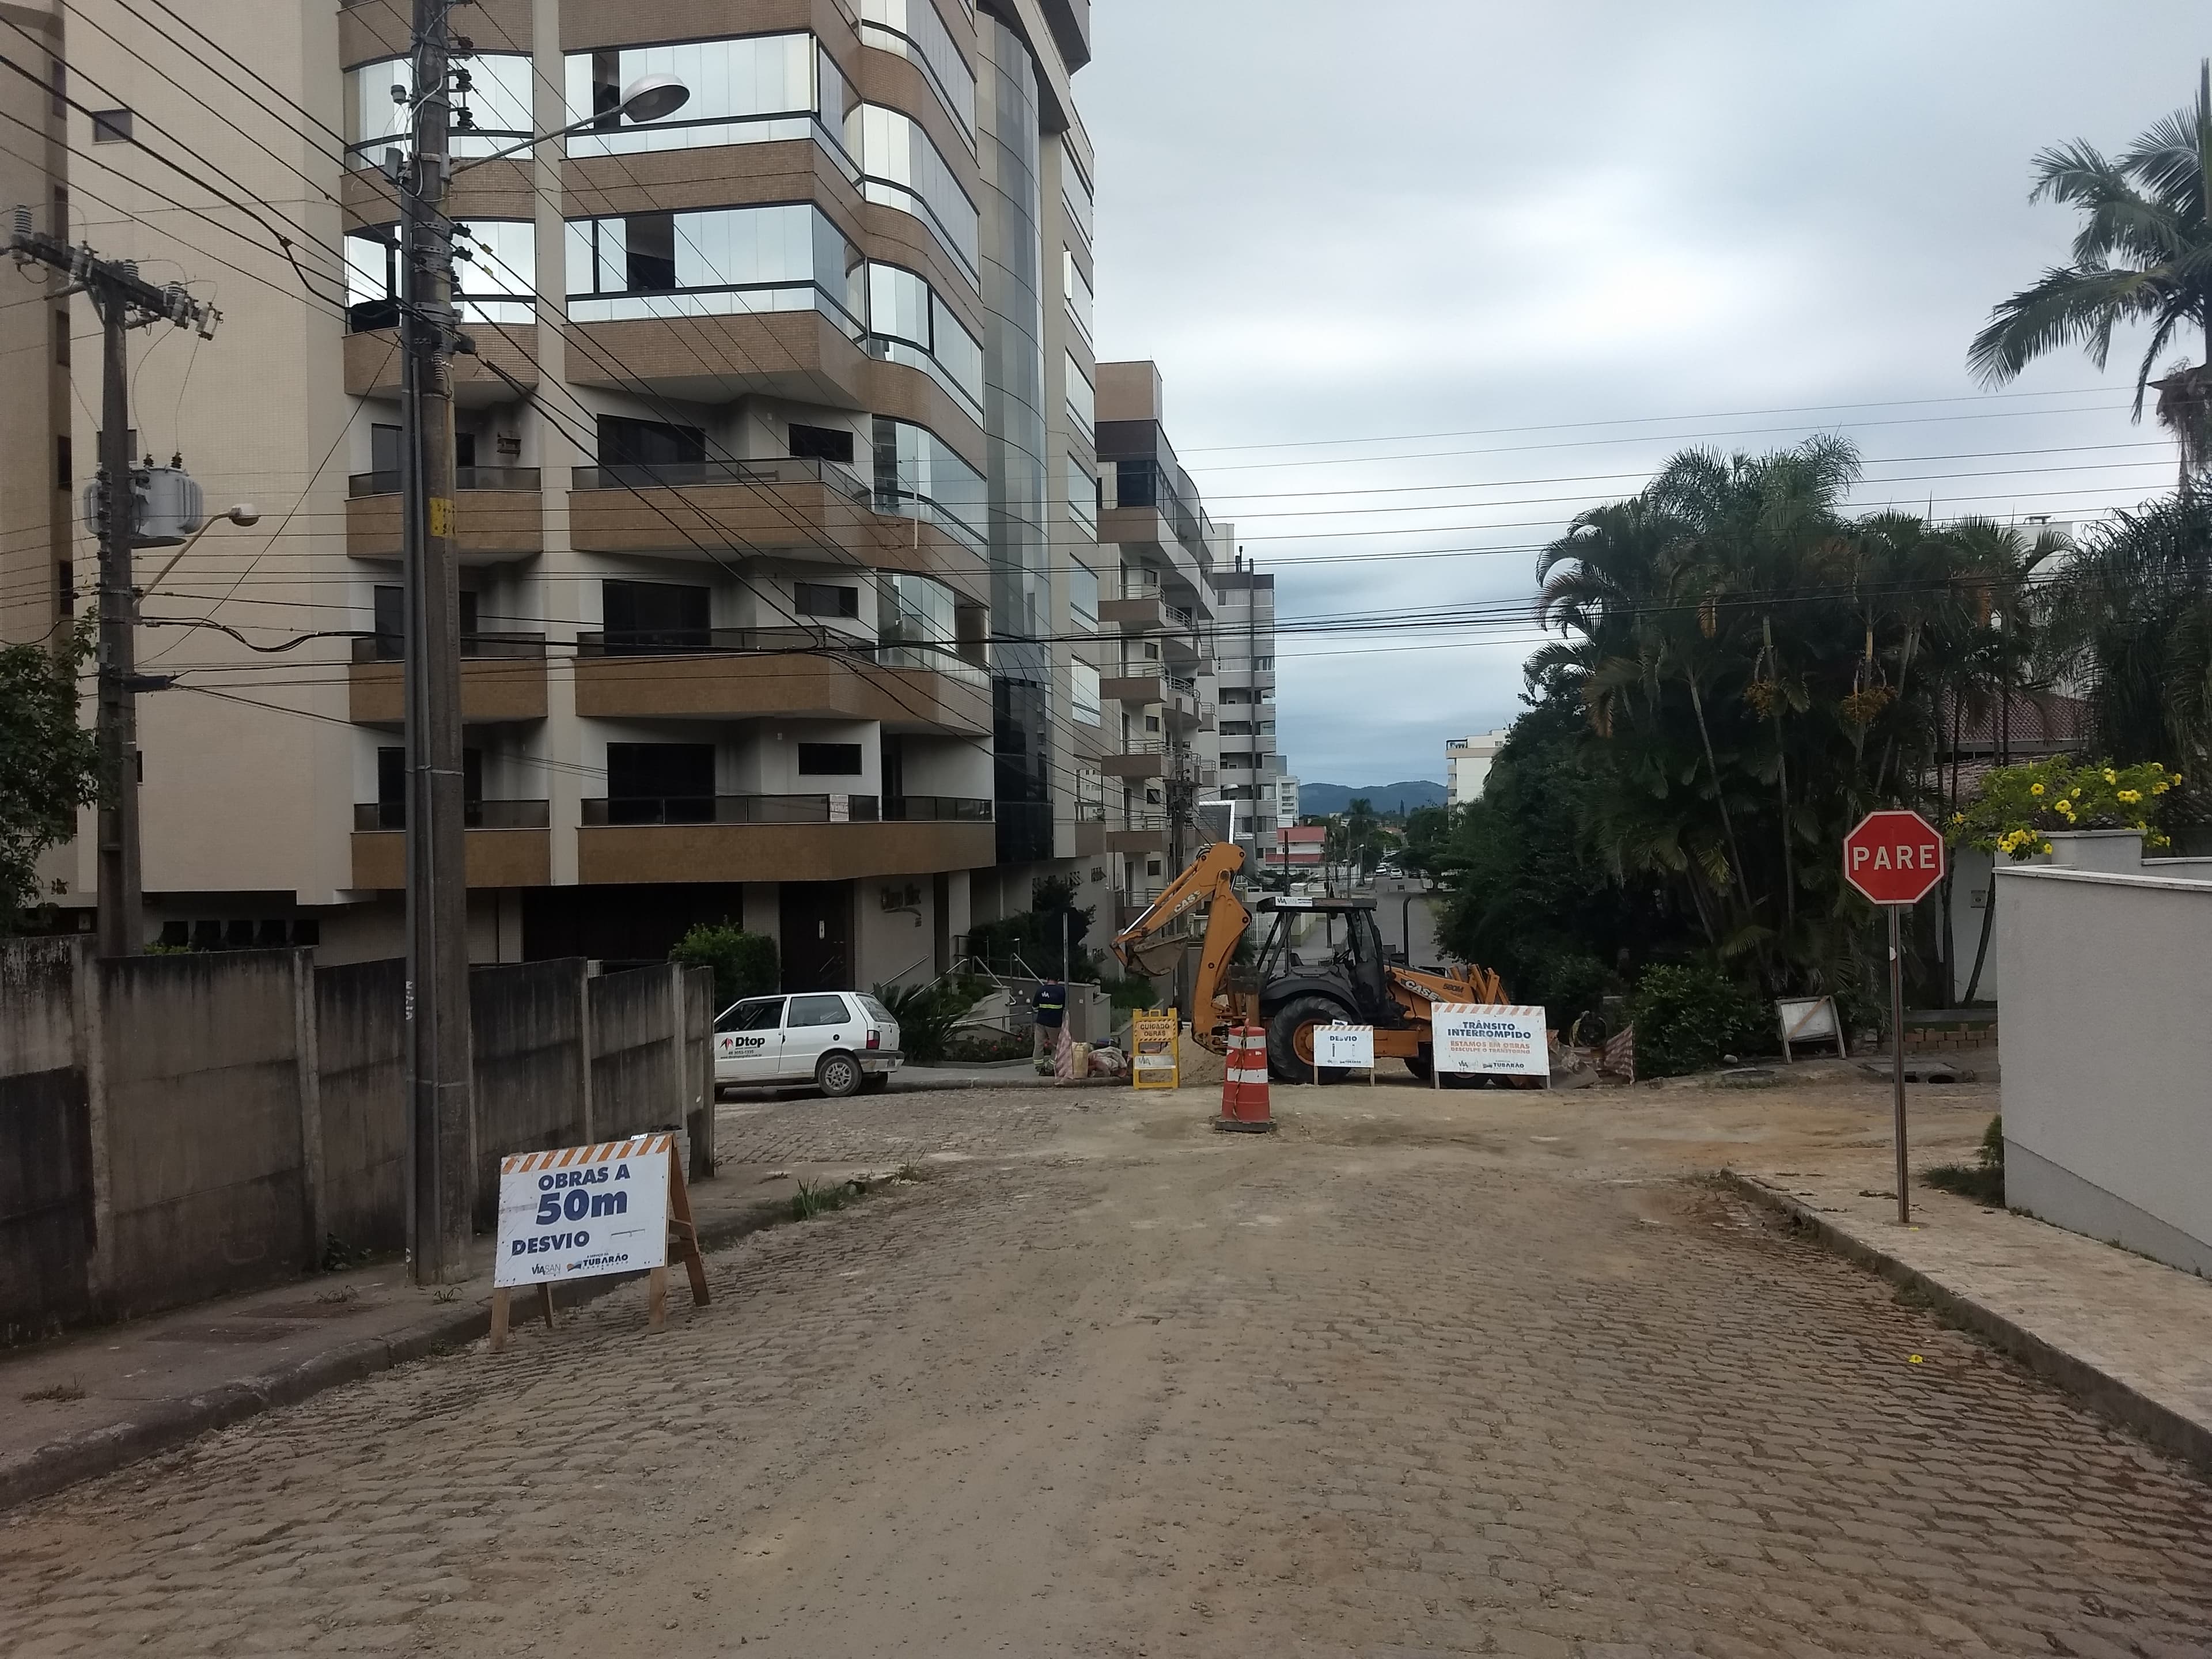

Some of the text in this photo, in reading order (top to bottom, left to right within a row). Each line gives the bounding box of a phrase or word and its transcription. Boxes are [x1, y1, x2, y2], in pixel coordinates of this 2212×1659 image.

[1853, 845, 1936, 870] PARE
[1174, 890, 1202, 913] CASE
[1405, 980, 1440, 1001] CASE
[1448, 1029, 1531, 1039] INTERROMPIDO
[1463, 1020, 1515, 1031] TRÂNSITO
[736, 1037, 766, 1048] Dtop
[538, 1164, 631, 1191] OBRAS A
[536, 1188, 627, 1225] 50m
[512, 1231, 590, 1256] DESVIO
[583, 1253, 628, 1266] TUBARÃO
